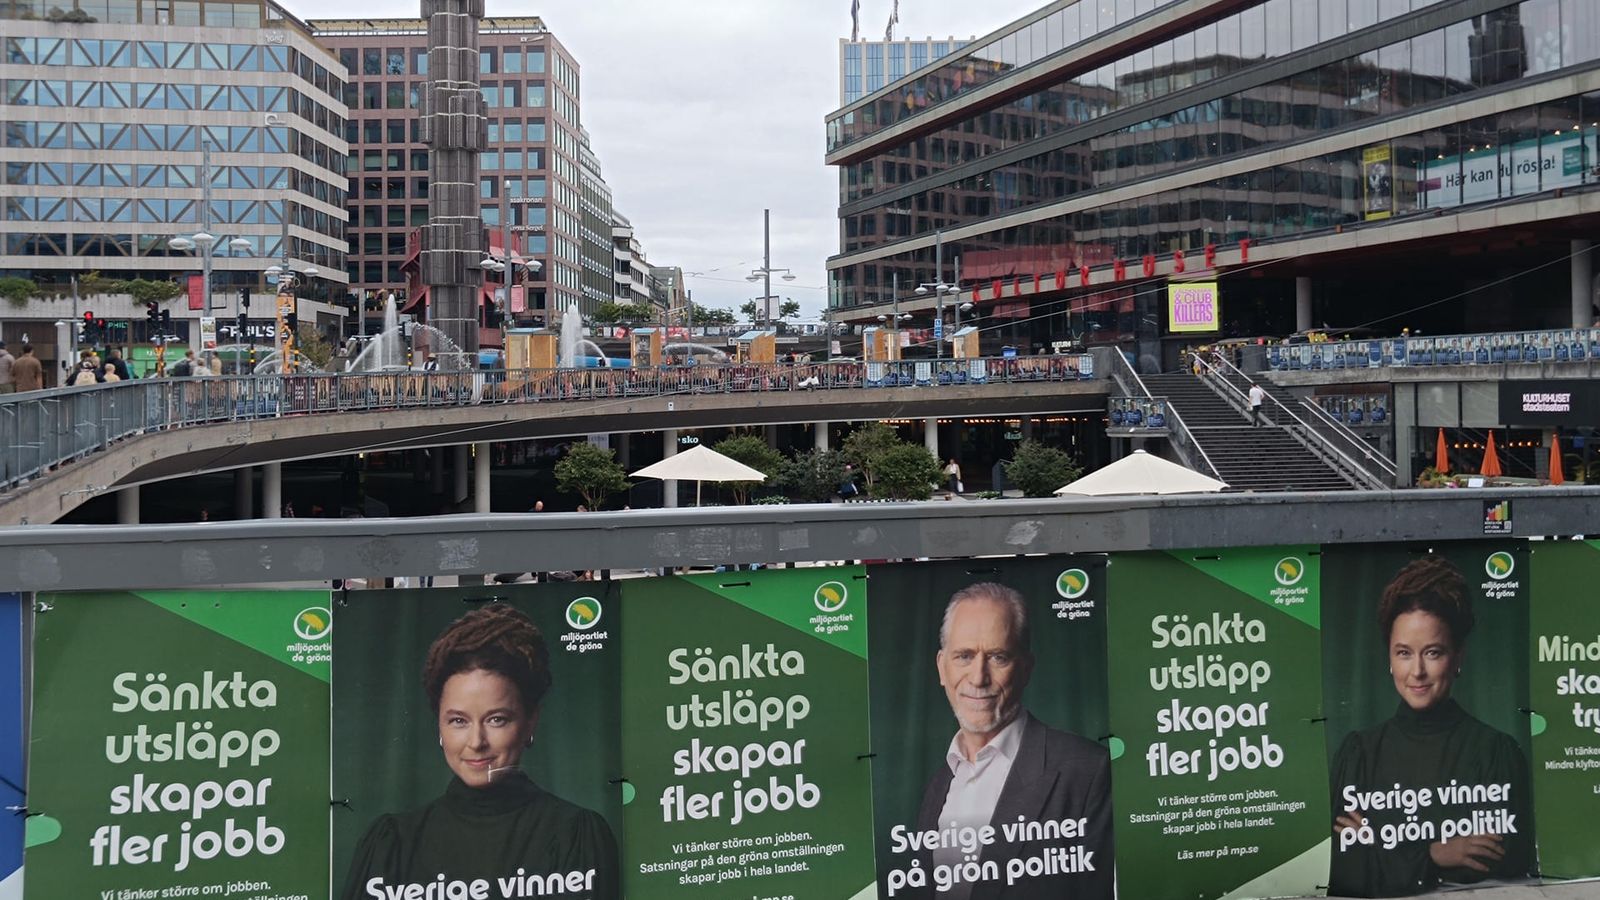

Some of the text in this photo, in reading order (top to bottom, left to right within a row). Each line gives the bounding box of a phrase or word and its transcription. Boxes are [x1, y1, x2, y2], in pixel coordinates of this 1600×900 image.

[1470, 169, 1493, 183] kan
[1499, 163, 1512, 178] du
[1517, 155, 1555, 175] rösa!
[971, 239, 1250, 305] KULTURHUSET
[1174, 303, 1213, 322] KILLERS
[1184, 292, 1212, 304] CLUB
[681, 435, 699, 444] sko
[809, 613, 853, 625] miljöpartiet
[814, 623, 849, 634] de gröna
[1151, 612, 1266, 649] Sänkta
[560, 631, 608, 643] miljöpartiet
[566, 641, 603, 653] de gröna
[1538, 635, 1600, 662] Mind
[668, 643, 805, 685] Sänkta
[1150, 655, 1271, 694] utsläpp
[112, 670, 278, 713] Sänkta
[1556, 668, 1600, 695] ska
[666, 689, 811, 732] utsläpp
[1156, 699, 1269, 737] skapar
[105, 721, 281, 769] utsläpp
[673, 738, 806, 778] skapar
[1146, 734, 1284, 781] fler jobb
[1564, 746, 1574, 756] Vi
[1545, 760, 1574, 769] Mindre
[110, 773, 272, 820] skapar
[660, 773, 821, 826] fler jobb
[1157, 789, 1279, 807] Vi tänker större om jobben.
[1342, 779, 1511, 815] Sverige vinner
[1129, 800, 1306, 824] Satsningar på den gröna omställningen
[1162, 817, 1275, 835] skapar jobb i hela landet.
[89, 816, 286, 872] fler jobb
[672, 831, 813, 855] Vi tänker större om jobben.
[890, 814, 1088, 854] Sverige vinner
[1339, 808, 1518, 852] på grön politik
[639, 842, 845, 874] Satsningar på den gröna omställningen
[1177, 845, 1259, 860] Läs mer på mp.se
[366, 867, 596, 900] Sverige vinner
[679, 861, 810, 886] skapar jobb i hela landet.
[887, 845, 1096, 897] på grön politik
[101, 889, 114, 900] Vi
[117, 888, 160, 900] tänker
[161, 885, 200, 898] större
[202, 883, 223, 896] om
[225, 881, 272, 897] jobben.
